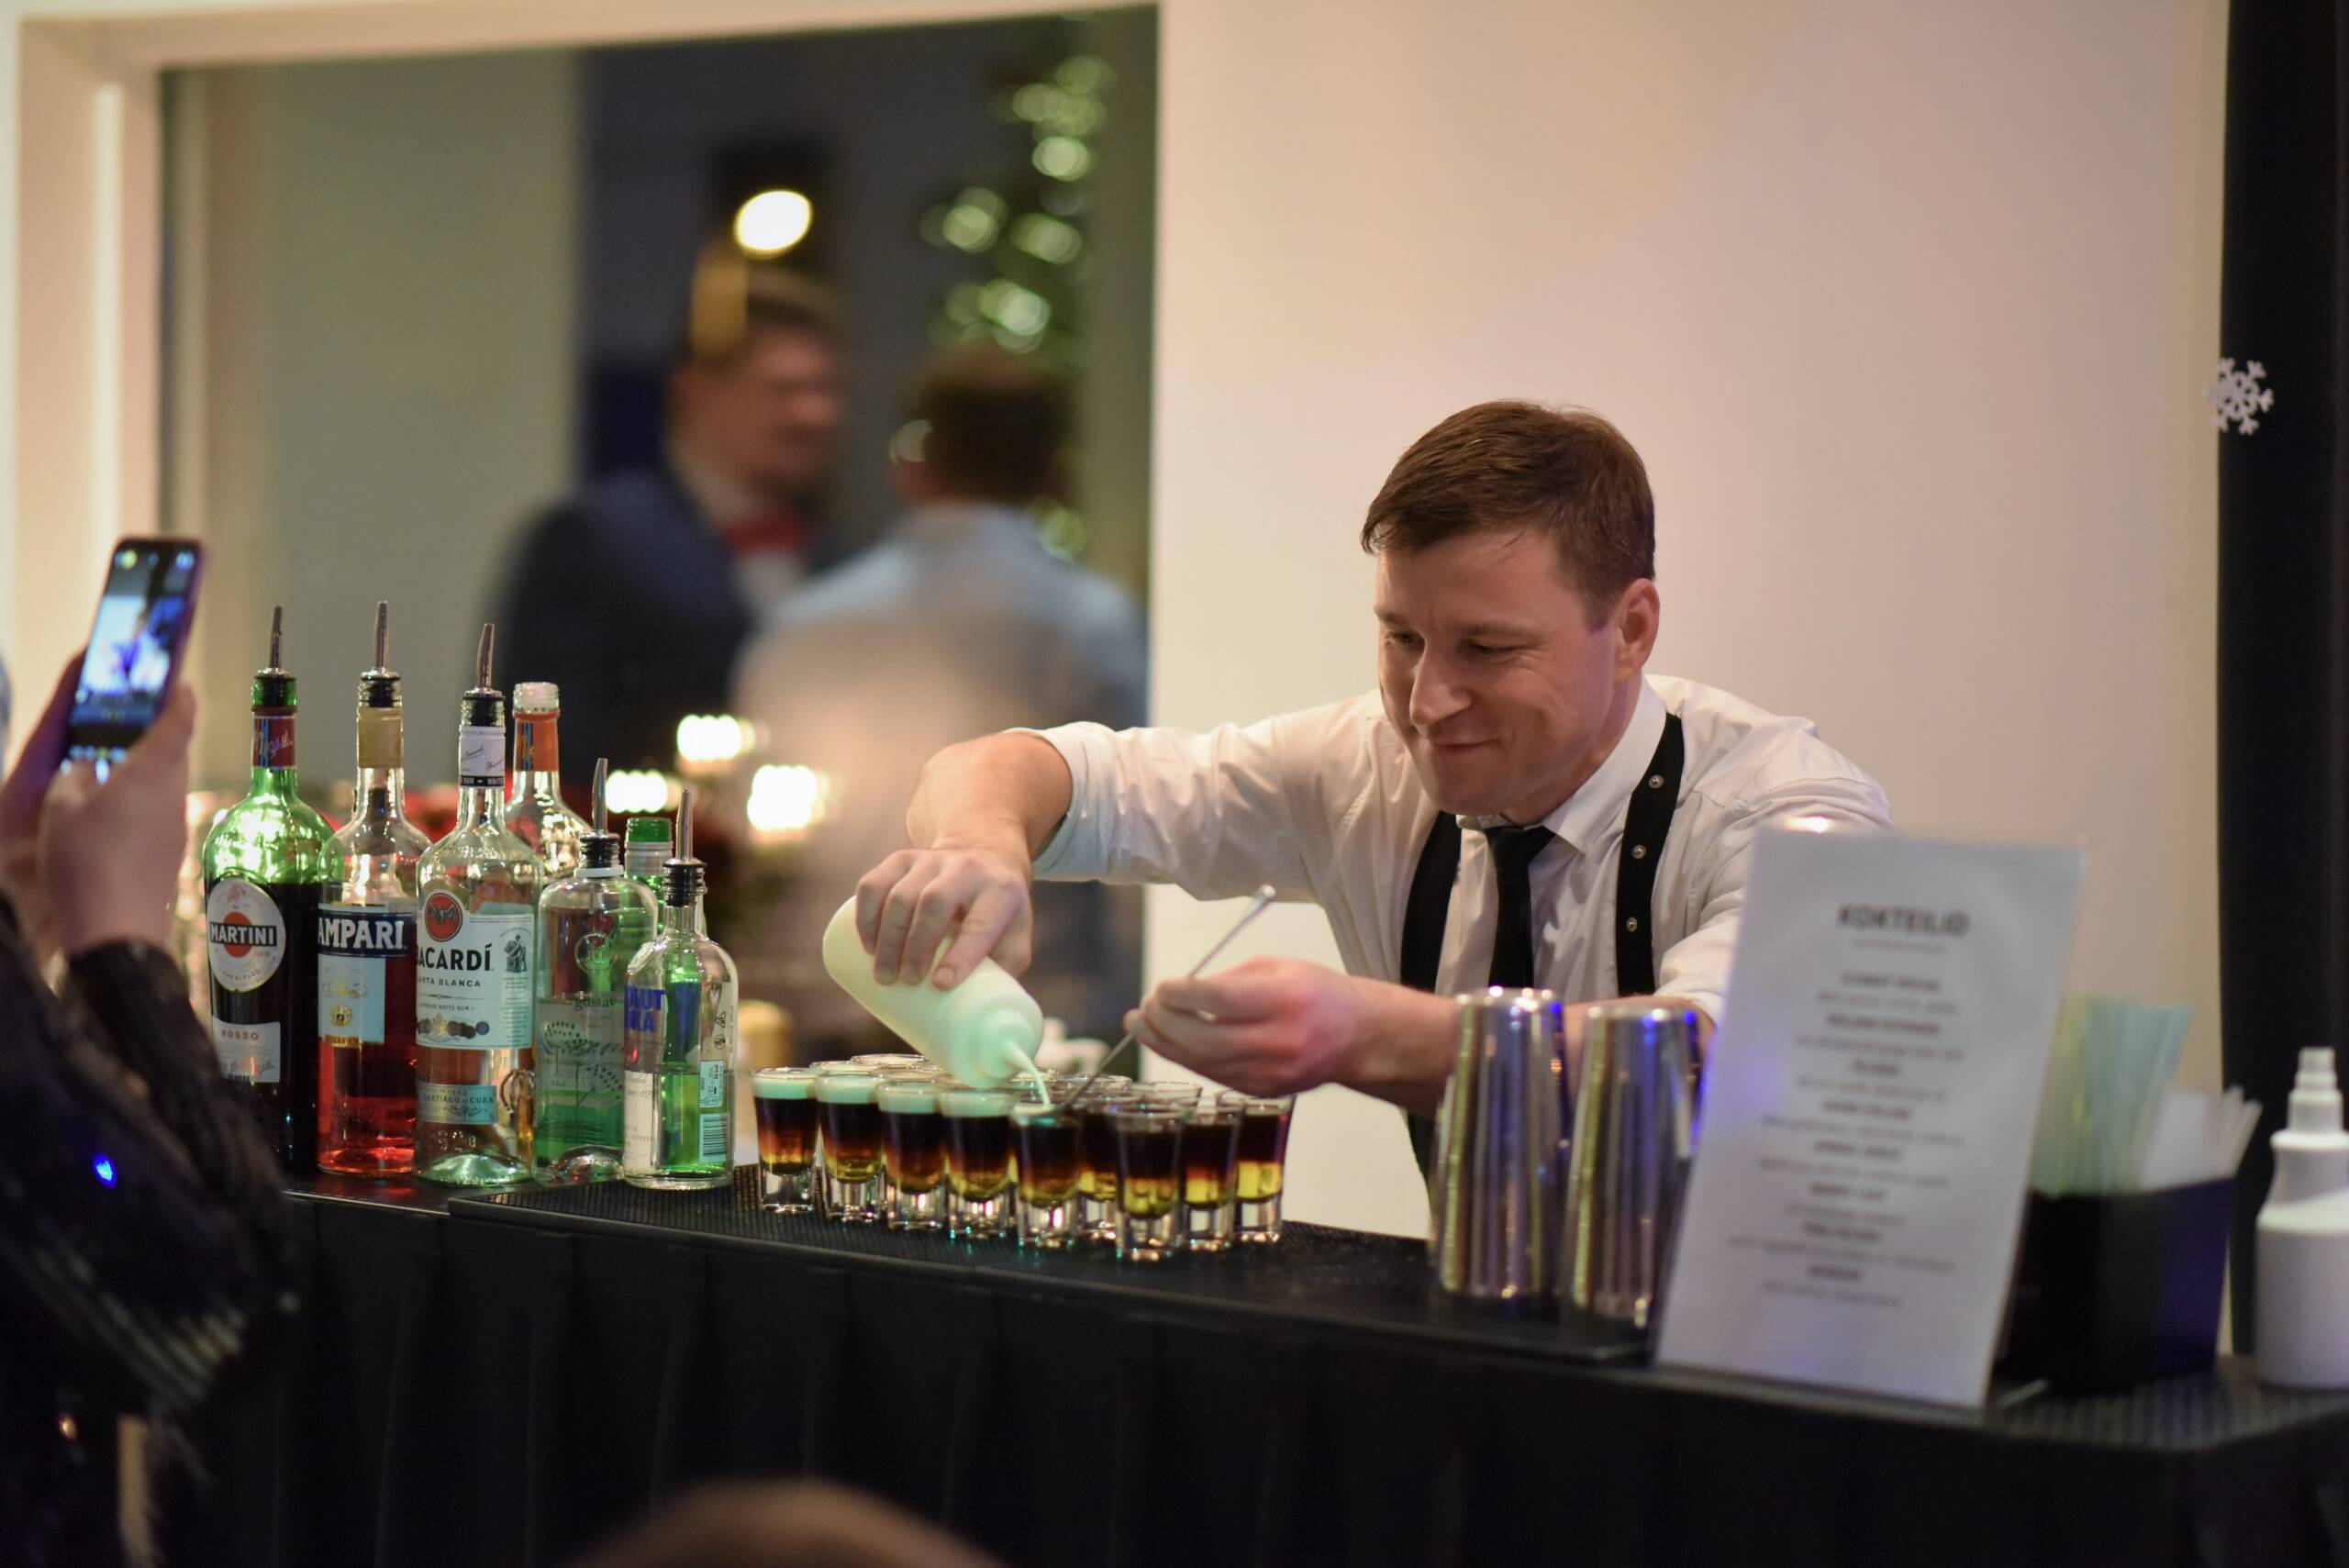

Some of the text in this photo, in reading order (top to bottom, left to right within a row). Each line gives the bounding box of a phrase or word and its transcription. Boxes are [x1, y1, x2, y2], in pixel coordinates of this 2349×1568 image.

[211, 924, 274, 946] MARTINI
[318, 917, 405, 950] AMPARI
[417, 942, 492, 972] ACARDÍ
[439, 978, 481, 987] BLANCA
[221, 1029, 259, 1041] ROSSO
